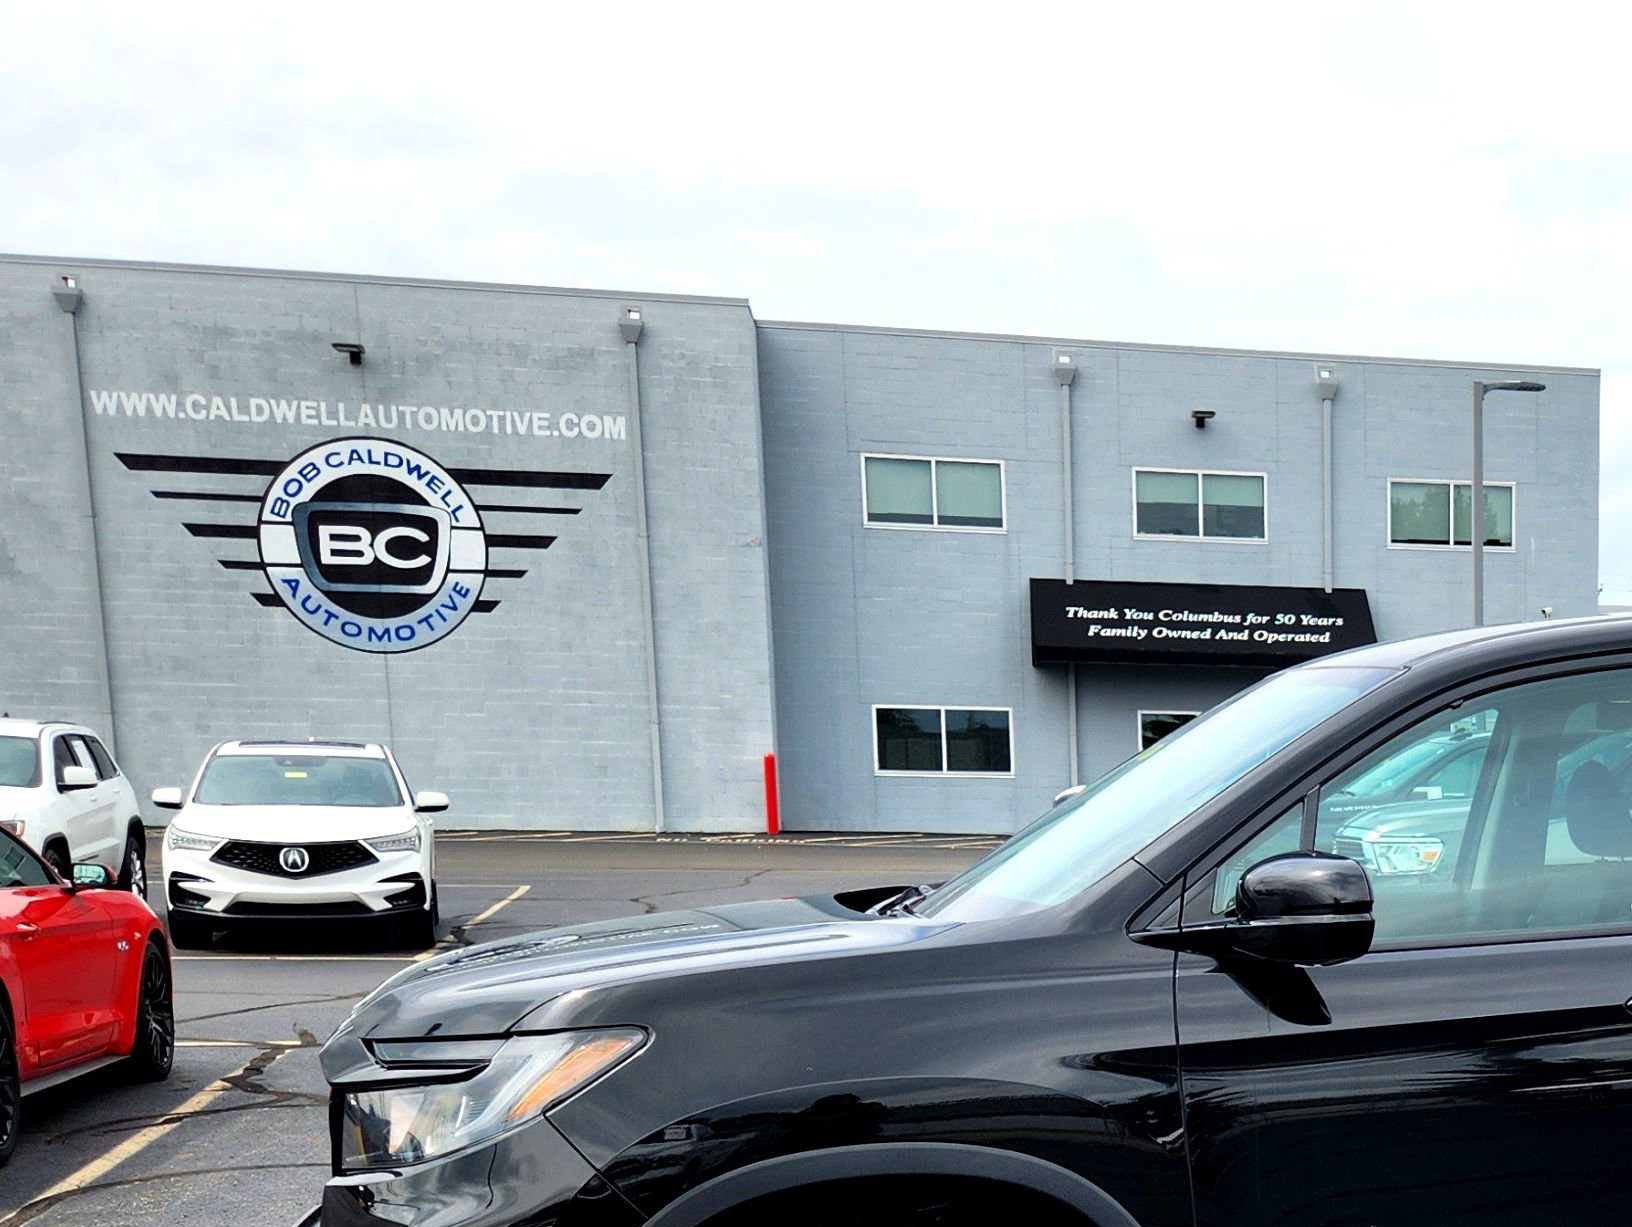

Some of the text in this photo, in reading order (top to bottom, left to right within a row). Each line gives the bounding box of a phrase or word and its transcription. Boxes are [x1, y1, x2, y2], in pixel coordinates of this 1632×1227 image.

[90, 390, 627, 440] WWW.CALDWELLAUTOMOTIVE.COM
[269, 448, 465, 523] BOB CALDWELL
[318, 525, 432, 569] BC
[280, 578, 471, 643] AUTOMOTIVE
[1065, 606, 1344, 627] Thank You Columbus for 50 Years
[1087, 624, 1331, 644] Family Owned And Operated
